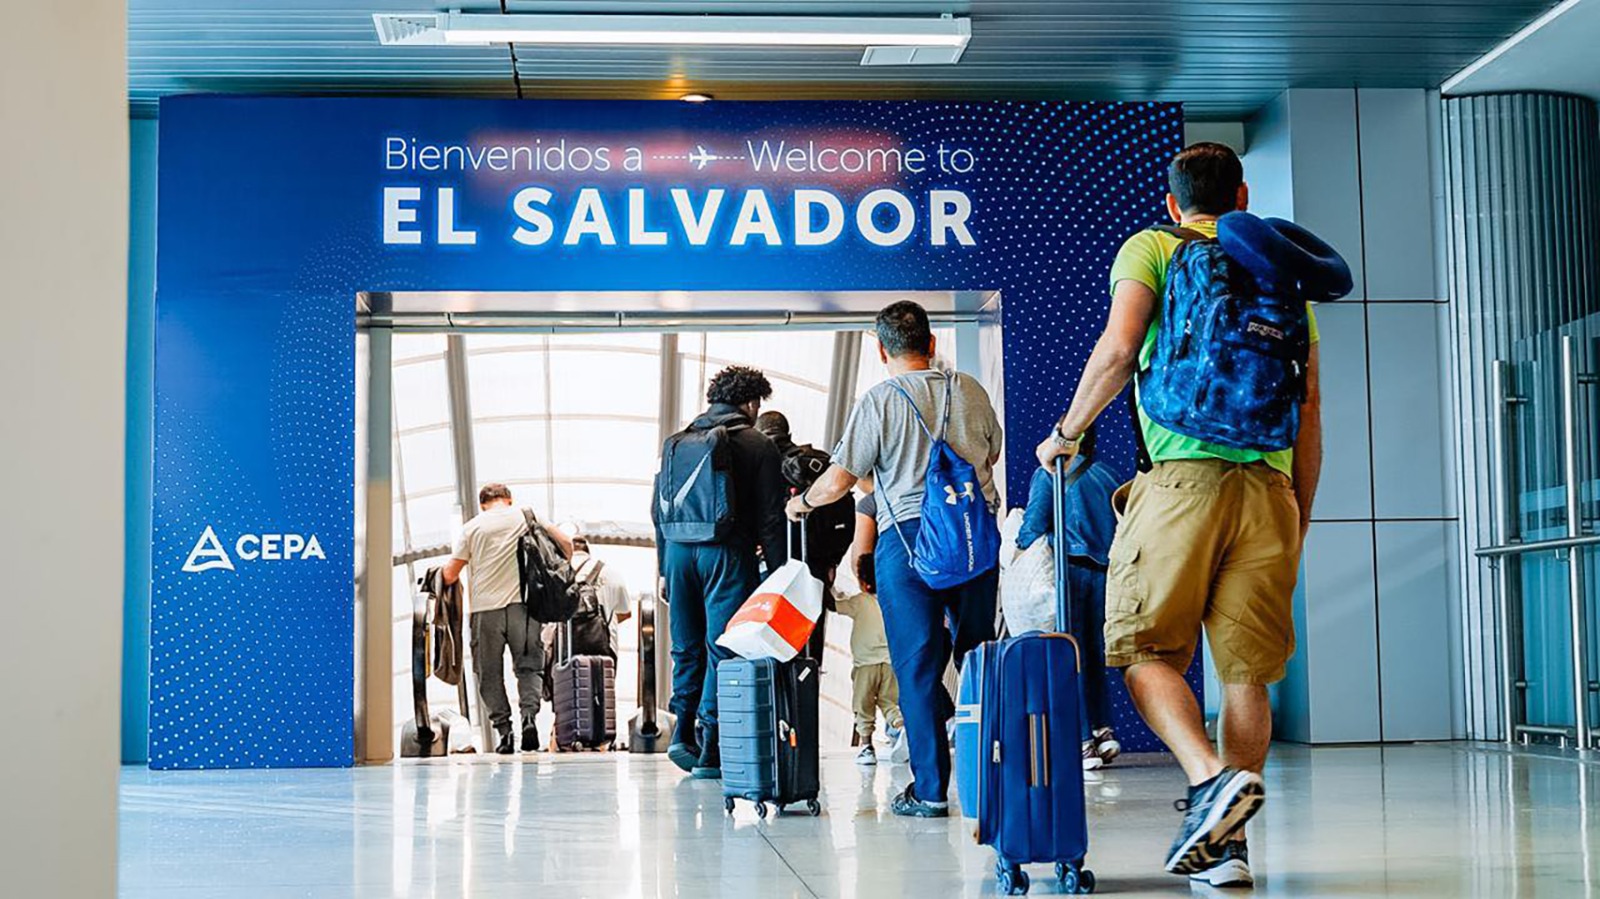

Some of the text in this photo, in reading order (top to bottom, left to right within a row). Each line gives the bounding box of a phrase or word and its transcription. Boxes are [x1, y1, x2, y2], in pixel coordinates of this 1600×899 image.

[384, 136, 643, 172] Bienvenidos a
[747, 139, 975, 174] Welcome to
[382, 187, 976, 247] EL SALVADOR
[963, 512, 972, 540] UNDER
[235, 534, 327, 560] CEPA
